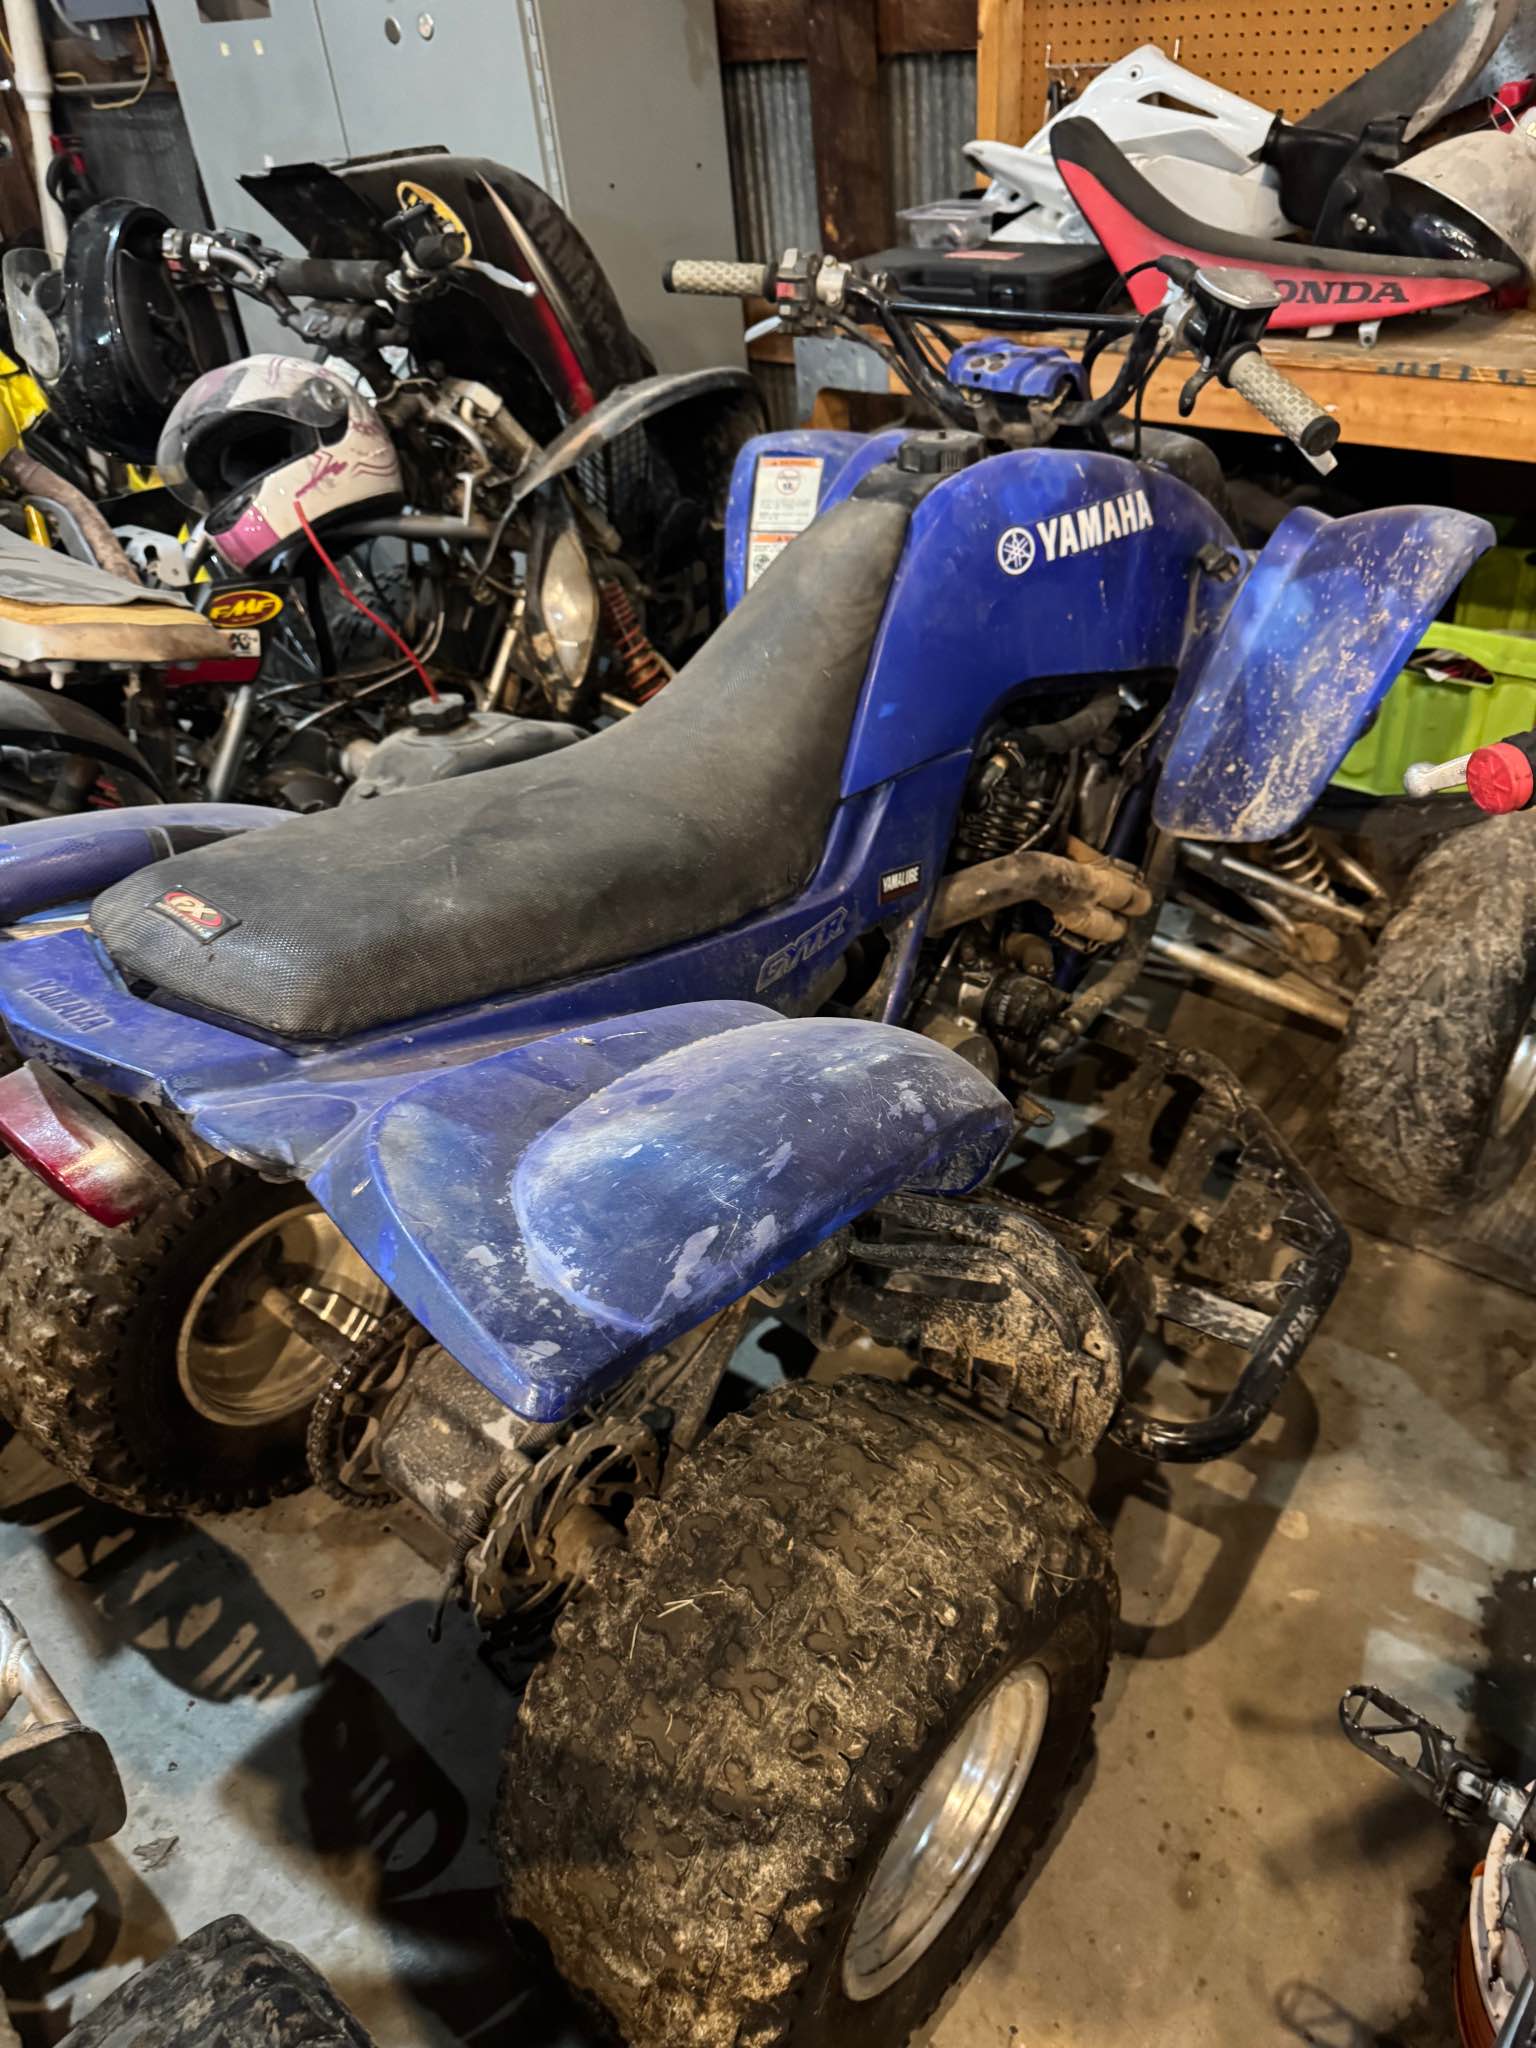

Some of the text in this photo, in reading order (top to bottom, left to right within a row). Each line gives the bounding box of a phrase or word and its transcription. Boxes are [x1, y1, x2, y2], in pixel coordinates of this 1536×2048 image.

[1272, 279, 1409, 304] ONDA
[1036, 489, 1154, 562] YAMAHA
[209, 598, 275, 619] FMF
[20, 978, 114, 1033] YAMAHA
[1269, 1304, 1319, 1367] TUSK
